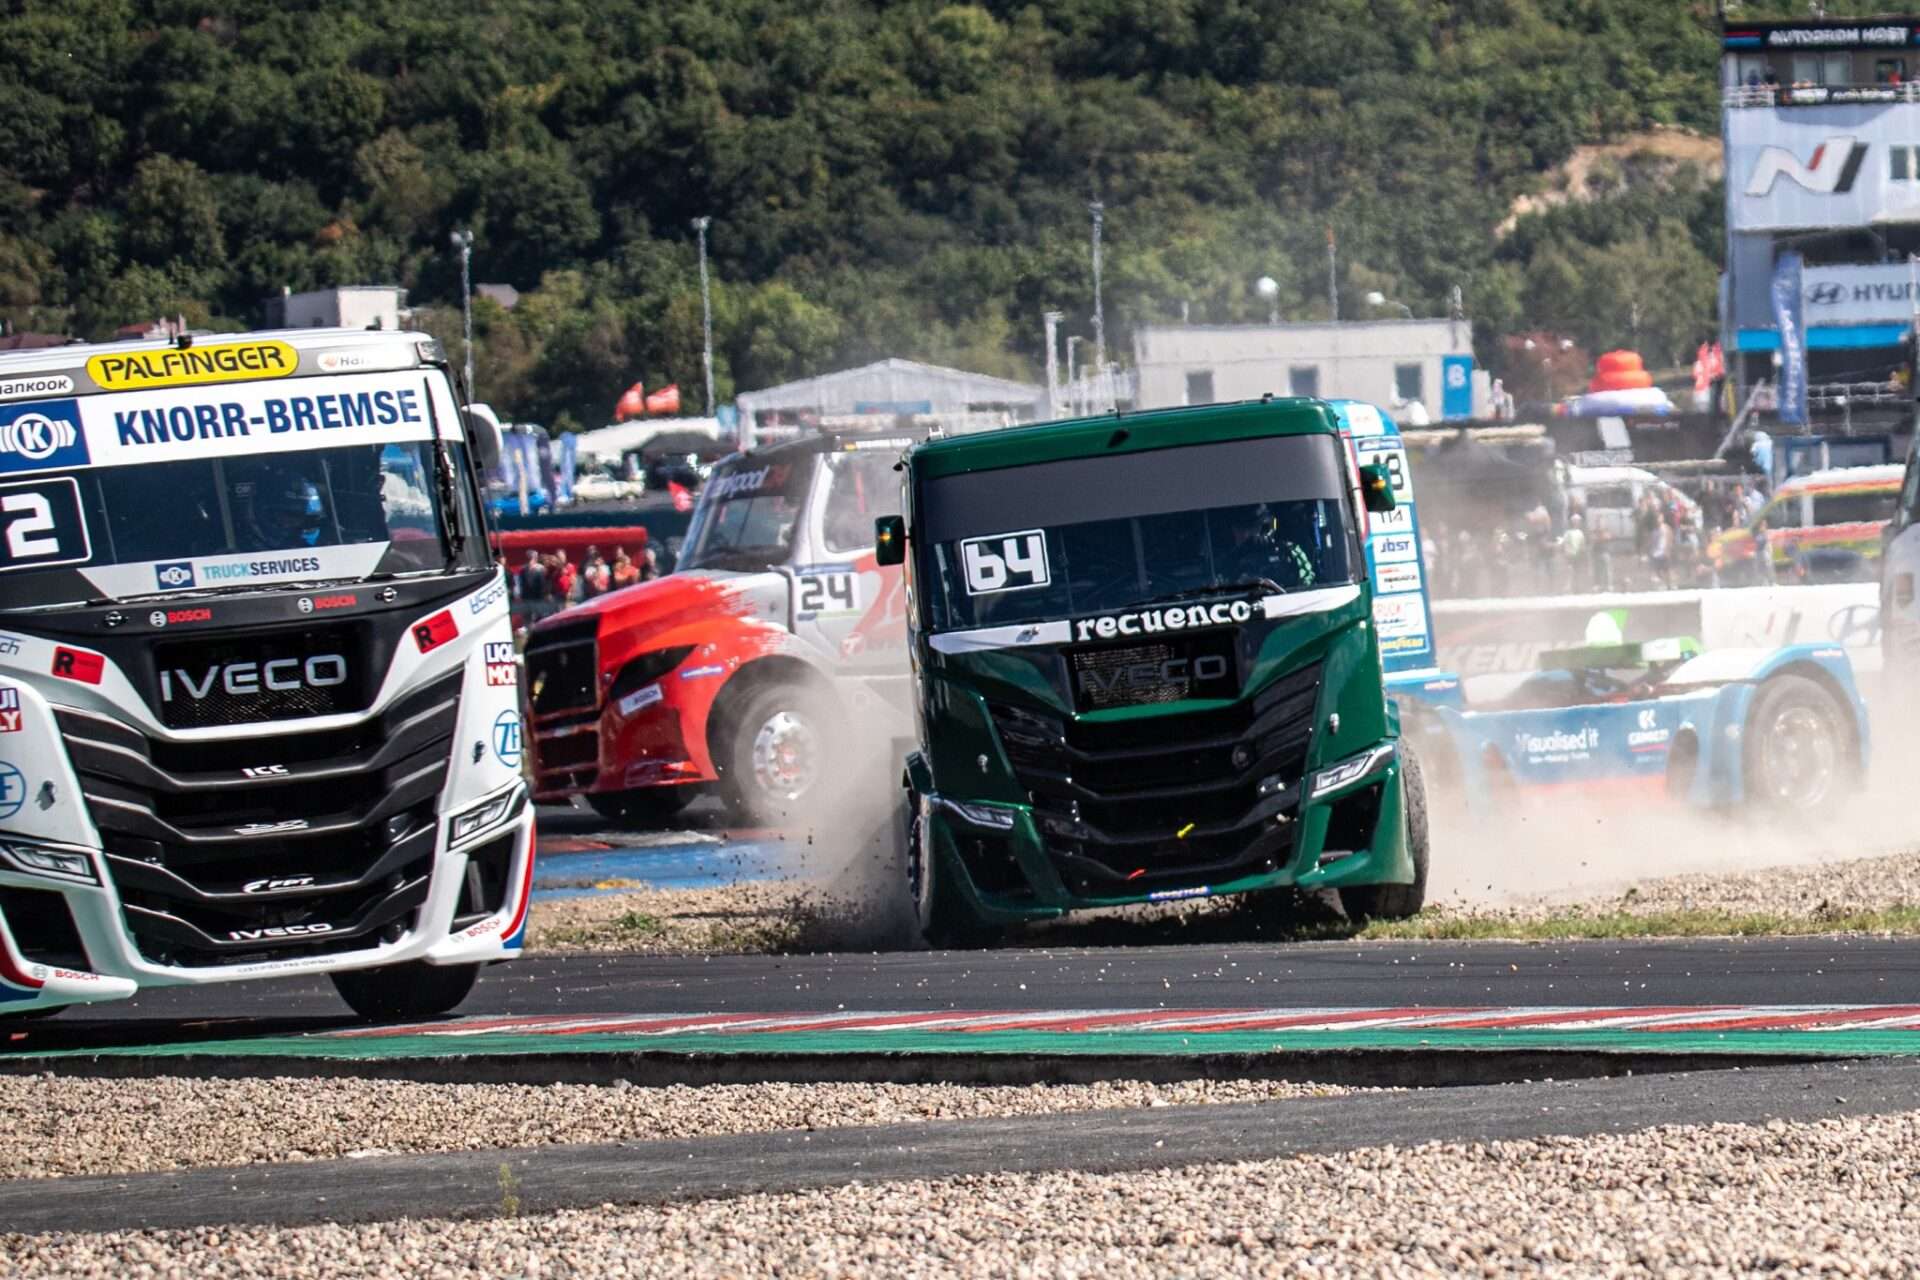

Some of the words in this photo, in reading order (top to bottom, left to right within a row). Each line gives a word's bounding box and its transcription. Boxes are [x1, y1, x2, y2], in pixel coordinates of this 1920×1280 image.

[100, 344, 286, 383] PALFINGER
[114, 389, 421, 447] KNORR-BREMSE
[2, 492, 60, 558] 2
[202, 556, 321, 582] TRUCKSERVICES
[965, 535, 1047, 591] 64
[315, 595, 356, 609] BOSCH
[801, 575, 854, 611] 24
[168, 608, 211, 623] BOSCH
[1075, 599, 1253, 642] recuenco
[159, 654, 347, 701] IVECO
[1077, 655, 1226, 694] IVECO
[229, 923, 333, 940] IVECO
[466, 919, 501, 937] BOSCH
[55, 969, 99, 981] BOSCH
